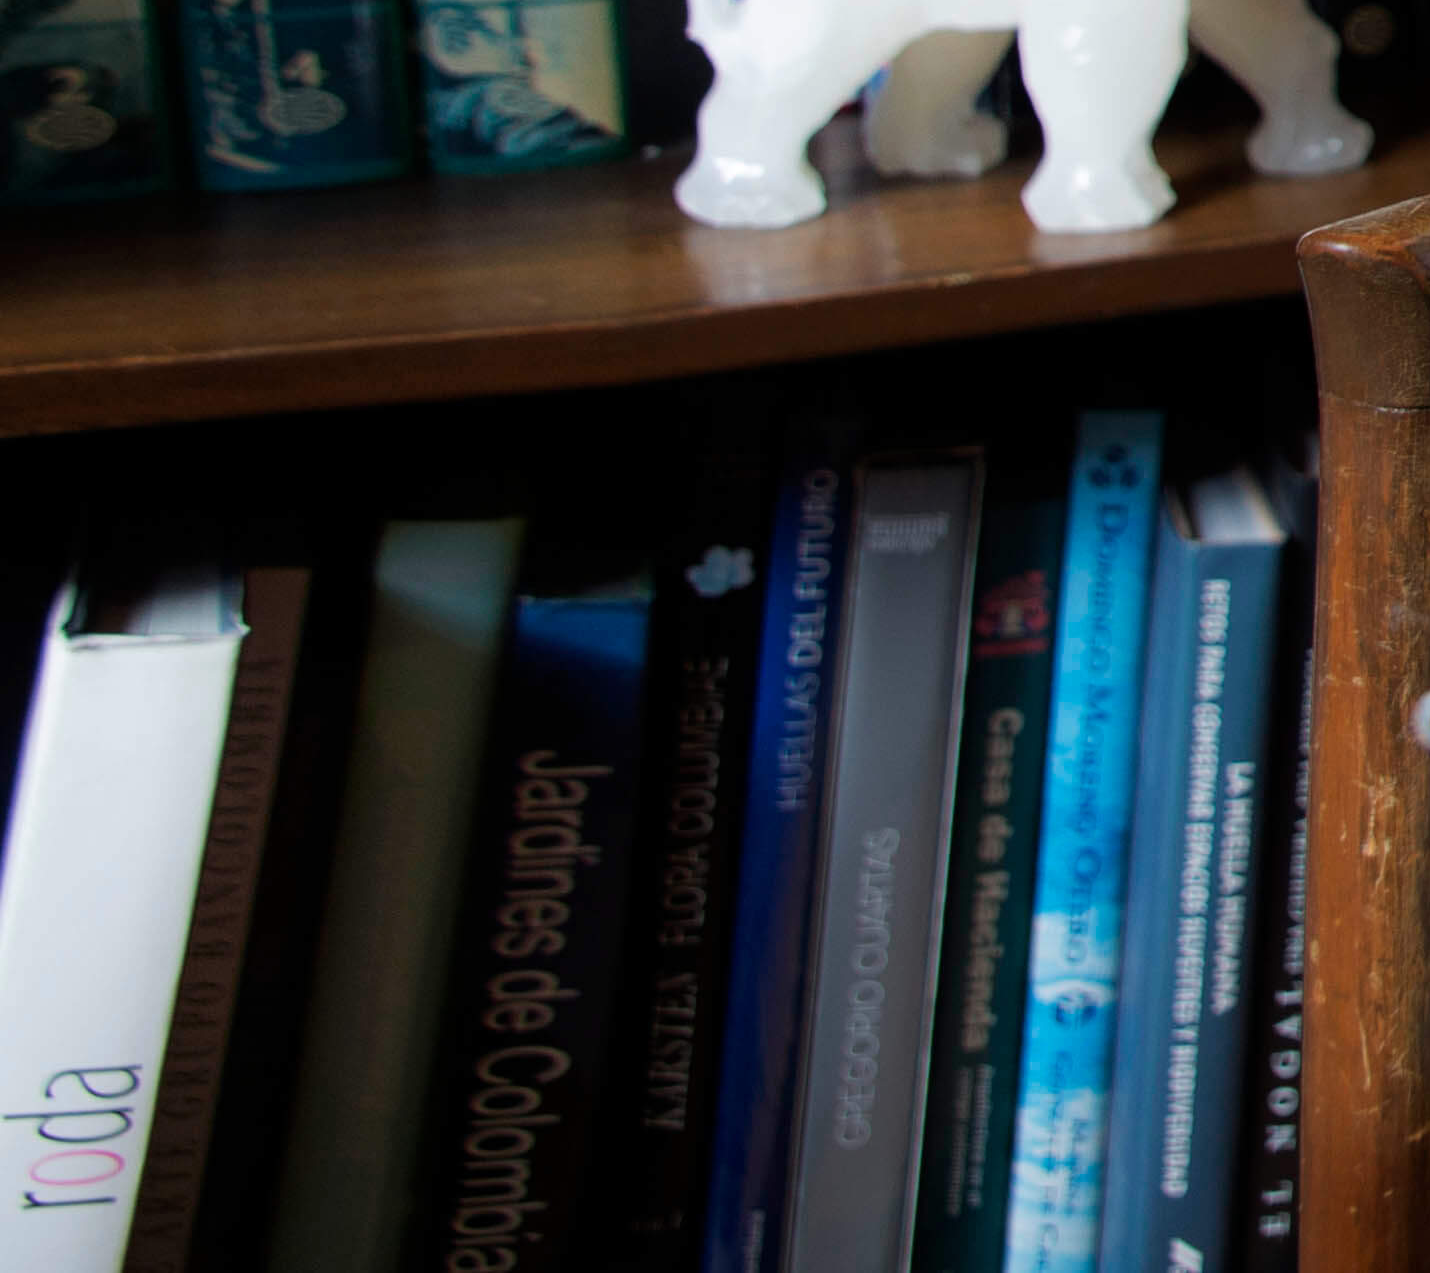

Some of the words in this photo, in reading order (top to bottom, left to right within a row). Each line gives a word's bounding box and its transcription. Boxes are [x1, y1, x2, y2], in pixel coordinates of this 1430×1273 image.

[794, 466, 840, 599] FUTURO
[787, 602, 830, 669] DEL
[1200, 577, 1230, 645] RETOS
[1196, 648, 1226, 703] PARA
[775, 671, 823, 811] HUELLAS
[982, 706, 1026, 803] Casa
[1189, 704, 1223, 819] CONSERVAR
[1225, 760, 1255, 799] LA
[187, 655, 283, 959] BANCOLOMBIA
[496, 750, 614, 960] Jardines
[975, 812, 1013, 858] de
[1217, 798, 1252, 897] HUELLA
[660, 844, 713, 949] FLORA
[846, 825, 902, 976] CUARTAS
[1182, 821, 1214, 912] ESPACIOS
[481, 968, 582, 1035] de
[957, 867, 1008, 1051] Hacienda
[1173, 914, 1208, 1026] SILVESTRES
[1209, 897, 1247, 1013] HUMANA
[160, 978, 221, 1120] GRUPO
[640, 970, 700, 1134] KARSTEN
[834, 979, 887, 1151] GREGORIO
[1264, 978, 1304, 1153] NOGAL
[4, 1063, 143, 1210] roda
[450, 1045, 574, 1273] Colombia
[1160, 1043, 1197, 1200] BIODIVERSIDAD
[1260, 1178, 1296, 1239] EL
